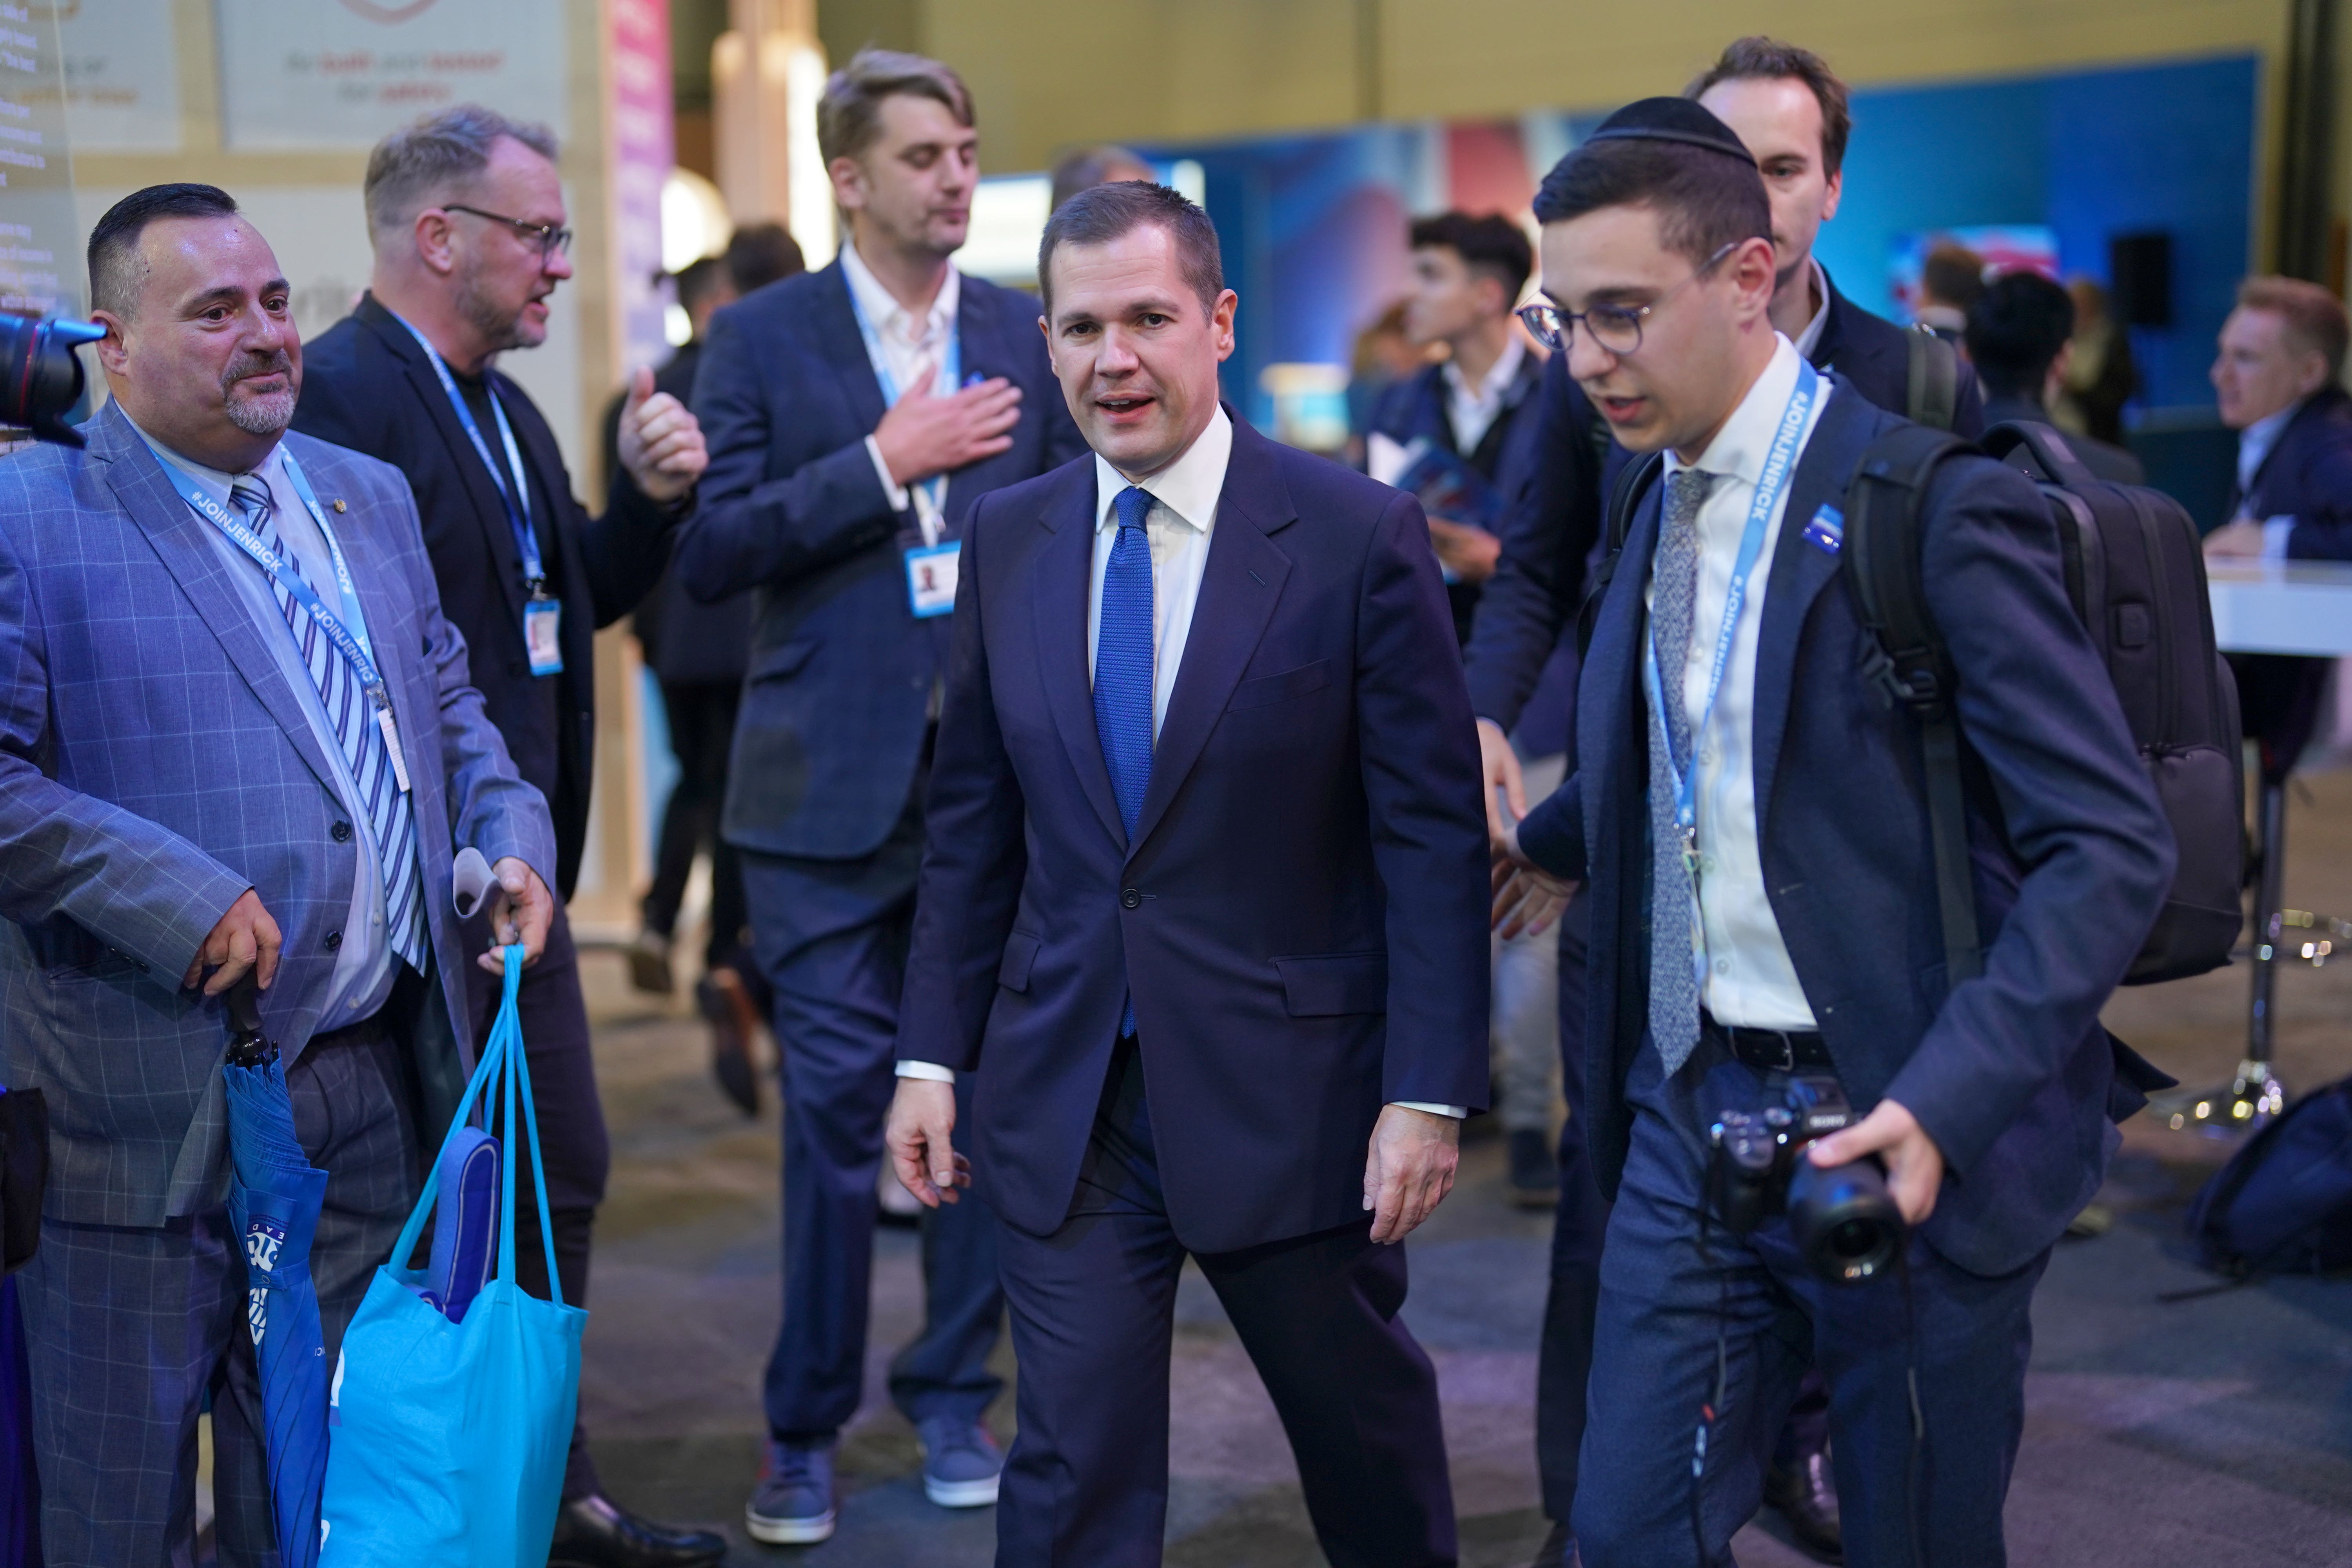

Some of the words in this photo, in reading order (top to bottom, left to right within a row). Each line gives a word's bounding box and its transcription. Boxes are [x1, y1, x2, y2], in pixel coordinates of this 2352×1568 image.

[1751, 391, 1809, 521] #JOINJENRICK
[192, 491, 283, 572] #JOINJENRICK
[310, 603, 373, 682] #JOINJENRIC
